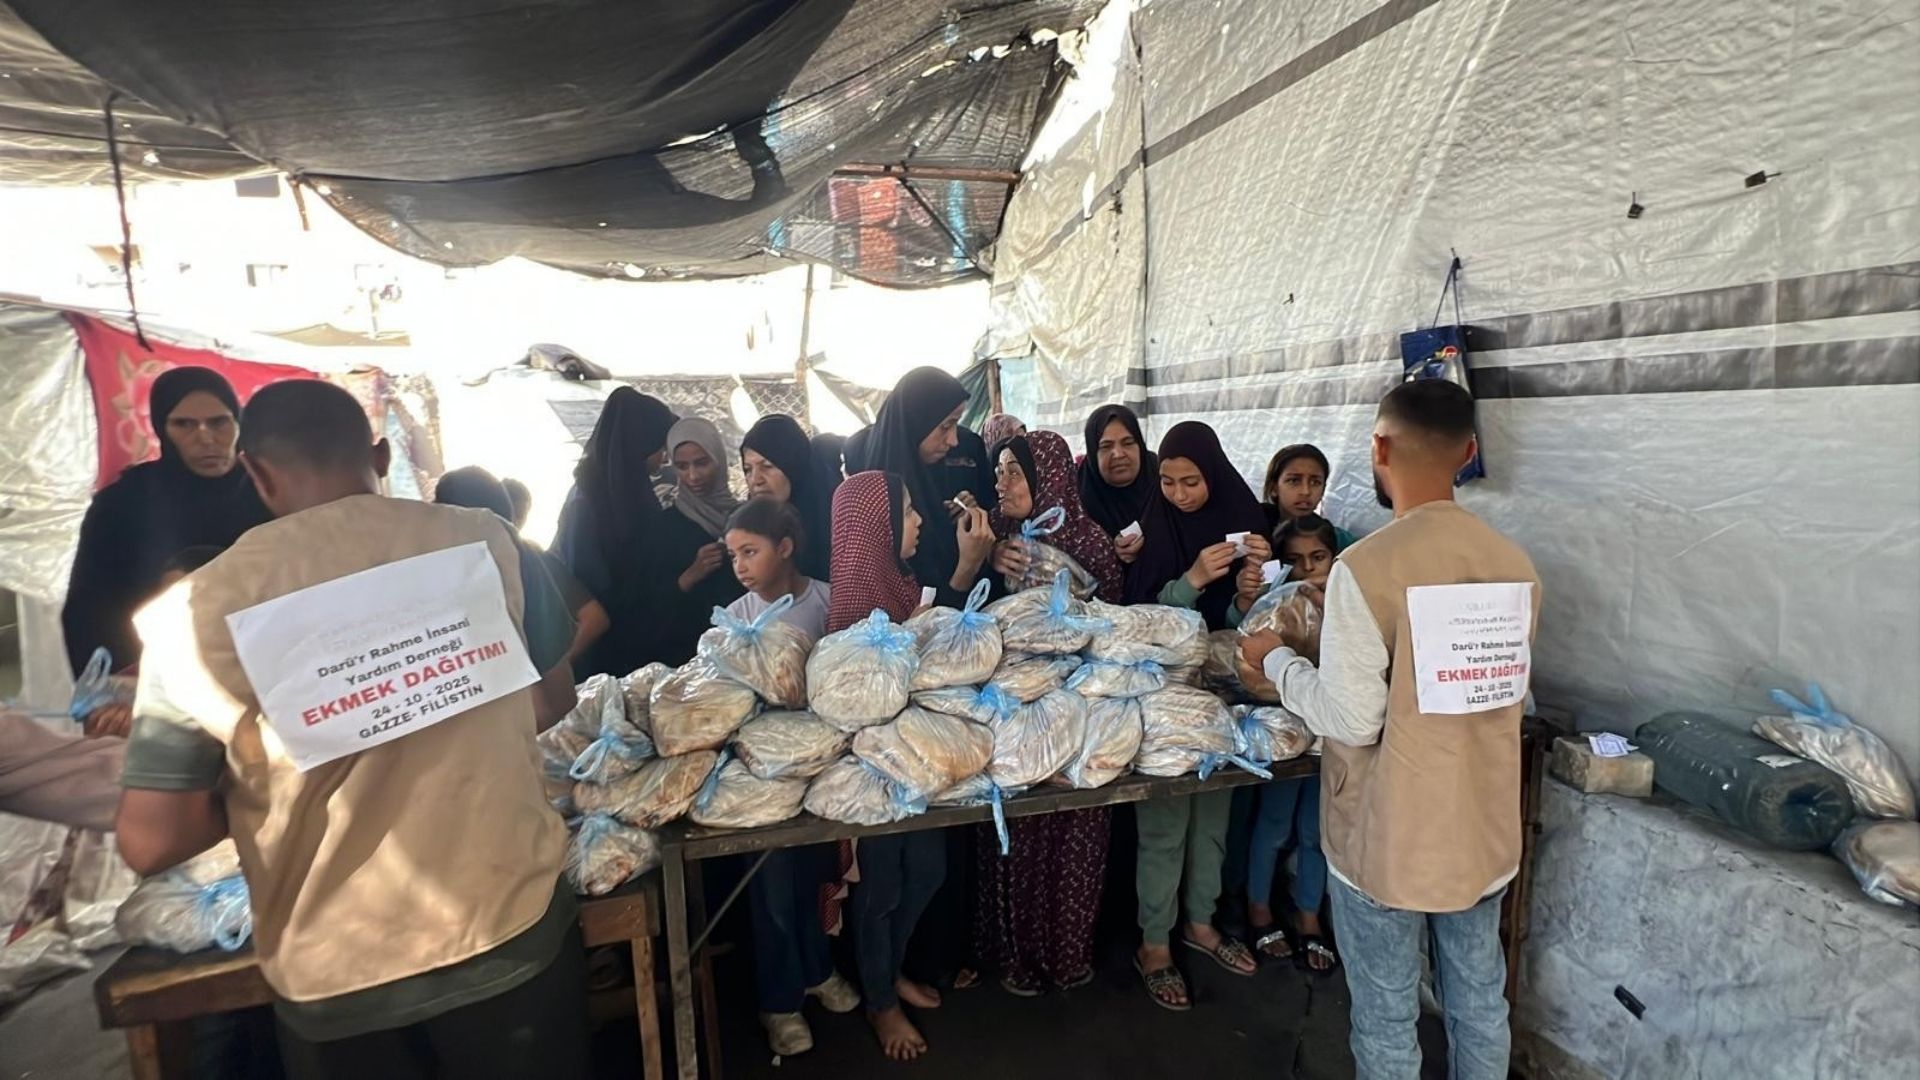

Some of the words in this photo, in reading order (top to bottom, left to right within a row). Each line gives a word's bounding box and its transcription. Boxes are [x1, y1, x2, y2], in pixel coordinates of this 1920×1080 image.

[317, 654, 366, 679] Darü'r
[370, 634, 423, 660] Rahme
[426, 617, 470, 640] İnsani
[346, 661, 401, 687] Yardım
[405, 639, 463, 665] Derneği
[1452, 641, 1478, 651] Darü'r
[302, 679, 397, 726] EKMEK
[403, 640, 507, 689] DAĞITIMI
[372, 705, 392, 719] 24
[404, 693, 422, 706] 10
[435, 675, 470, 694] 2025
[1437, 668, 1488, 682] EKMEK
[359, 712, 416, 739] GAZZE-
[420, 684, 484, 714] FİLİSTİN
